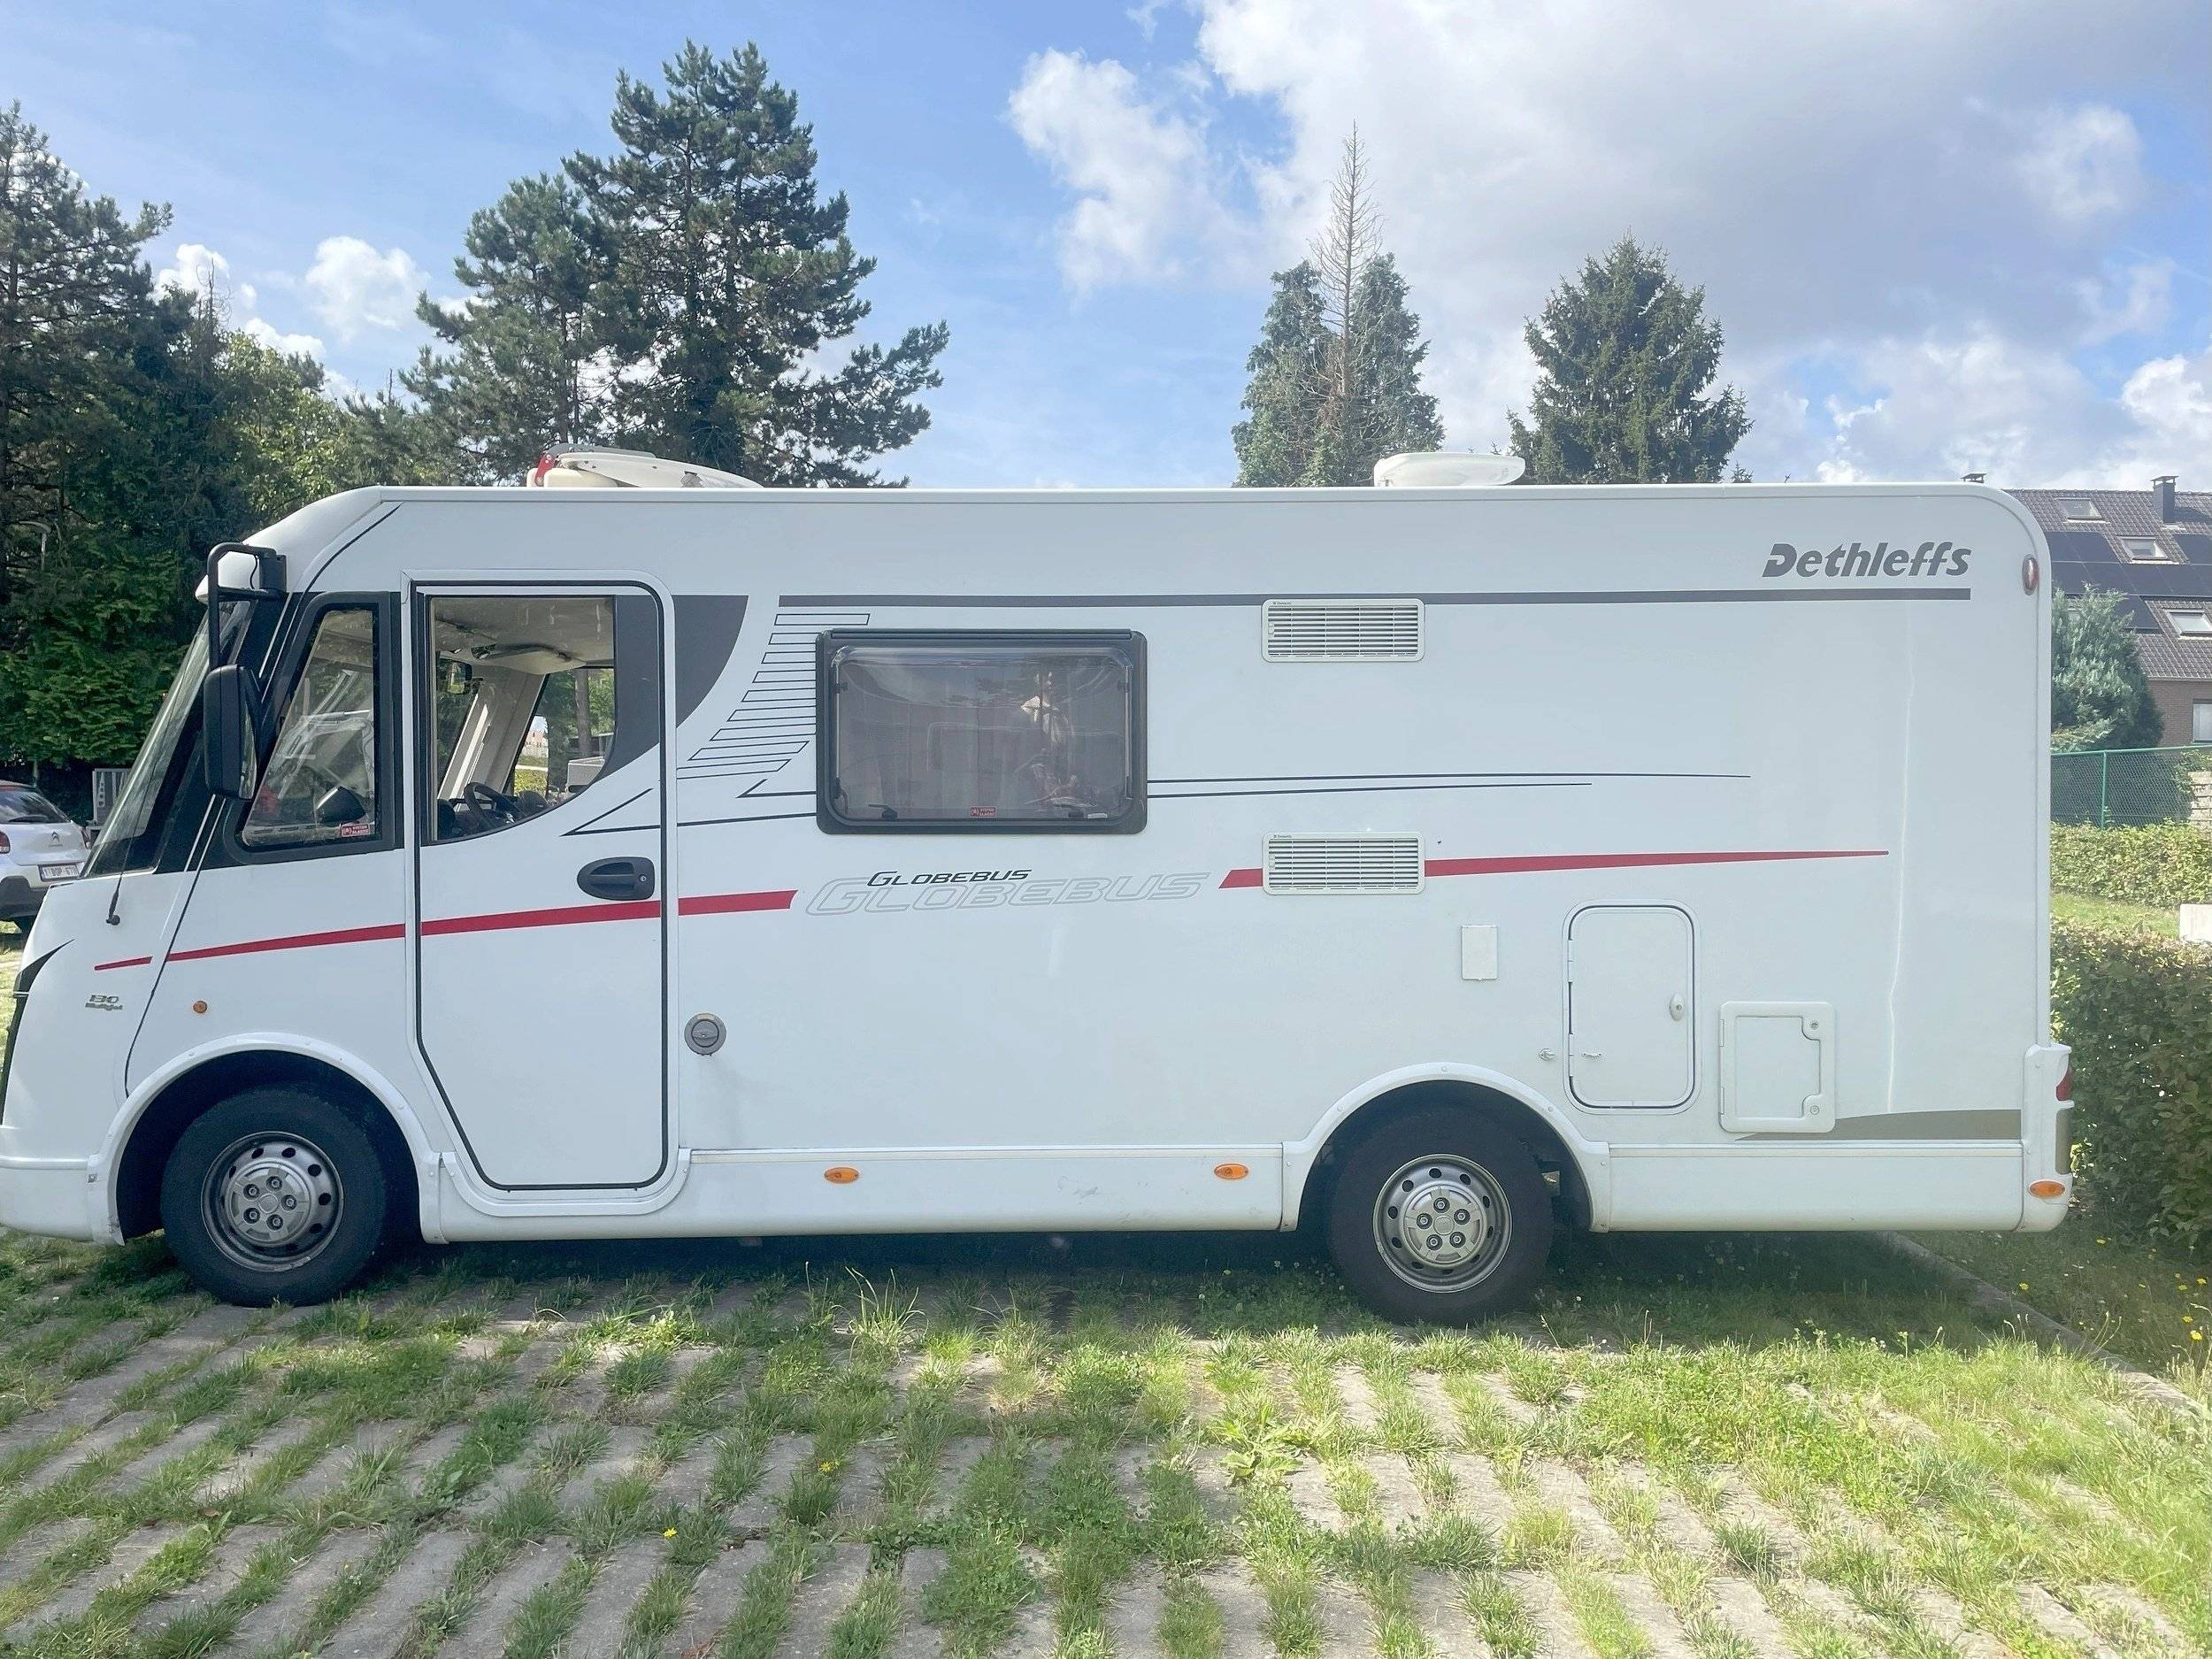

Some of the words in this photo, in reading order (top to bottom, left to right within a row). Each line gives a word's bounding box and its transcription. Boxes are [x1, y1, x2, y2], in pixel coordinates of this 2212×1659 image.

[1762, 541, 1972, 578] Dethleffs
[805, 872, 1212, 917] GLOBEBUS
[867, 869, 1033, 887] GLOBEBUS
